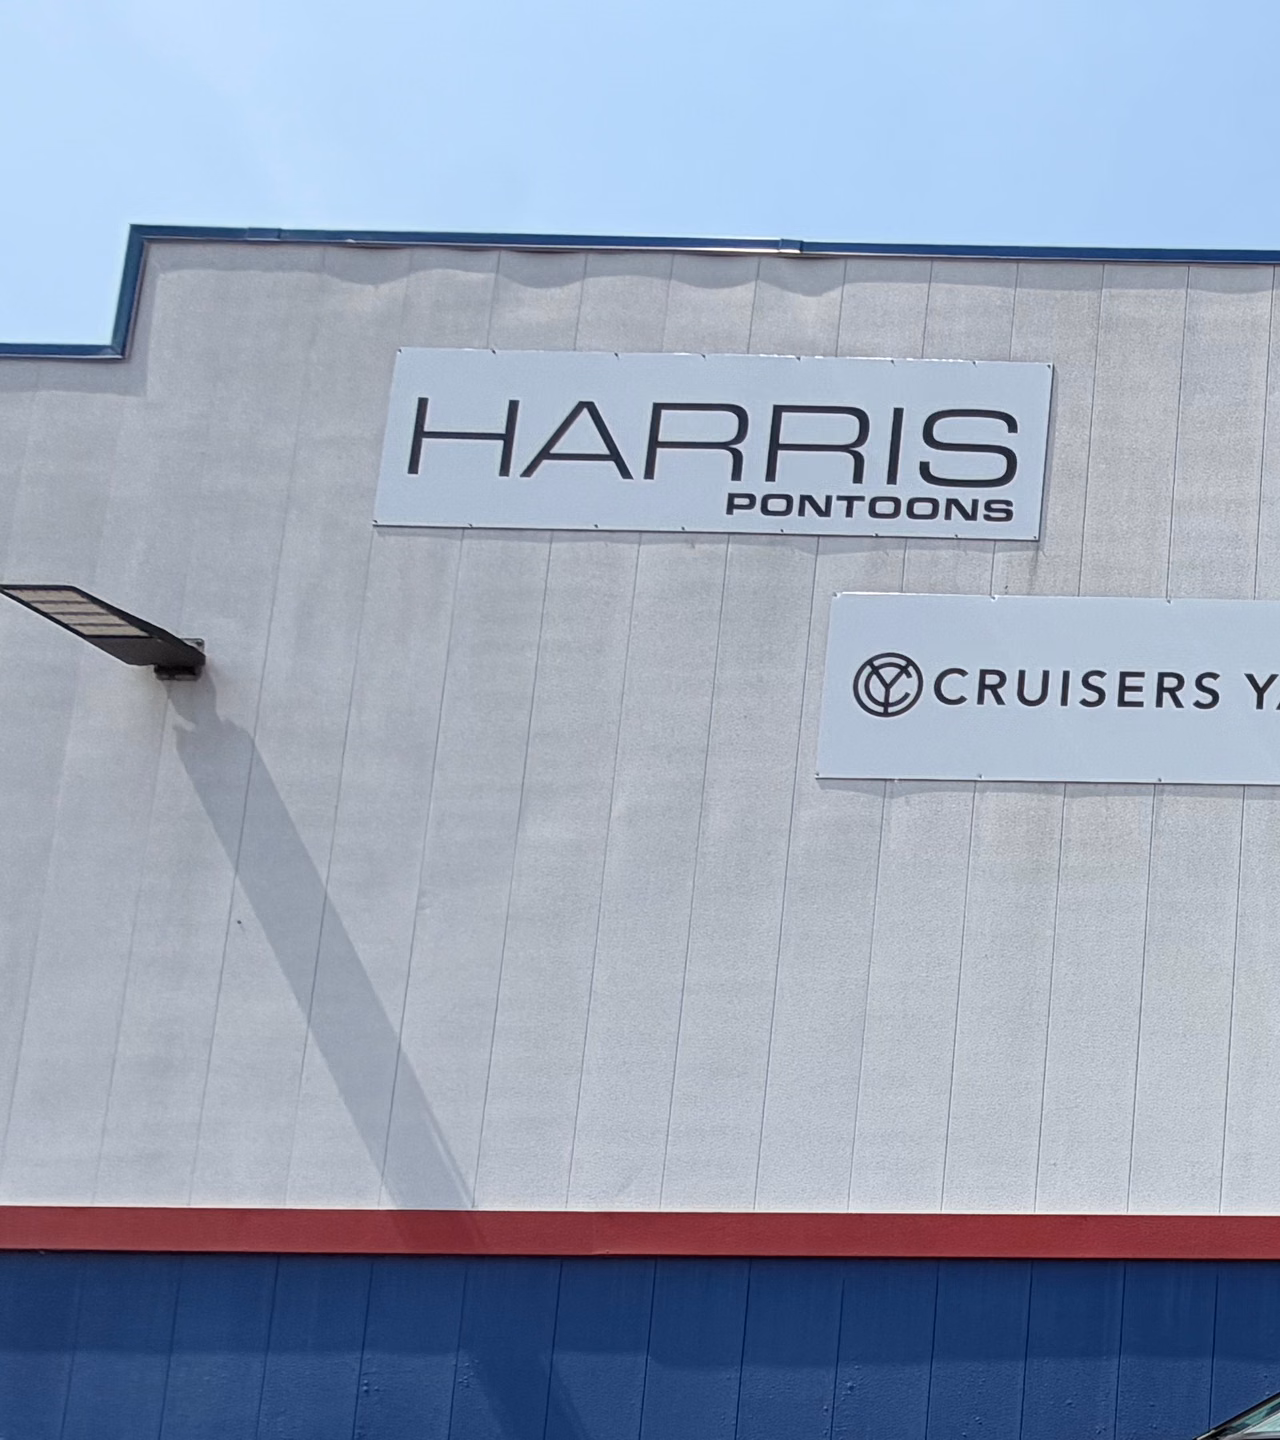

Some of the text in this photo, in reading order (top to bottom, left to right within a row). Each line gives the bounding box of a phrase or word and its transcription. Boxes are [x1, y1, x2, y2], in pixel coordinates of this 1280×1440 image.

[407, 396, 1018, 489] HARRIS
[725, 492, 1014, 523] PONTOONS
[933, 667, 1221, 710] CRUISERS
